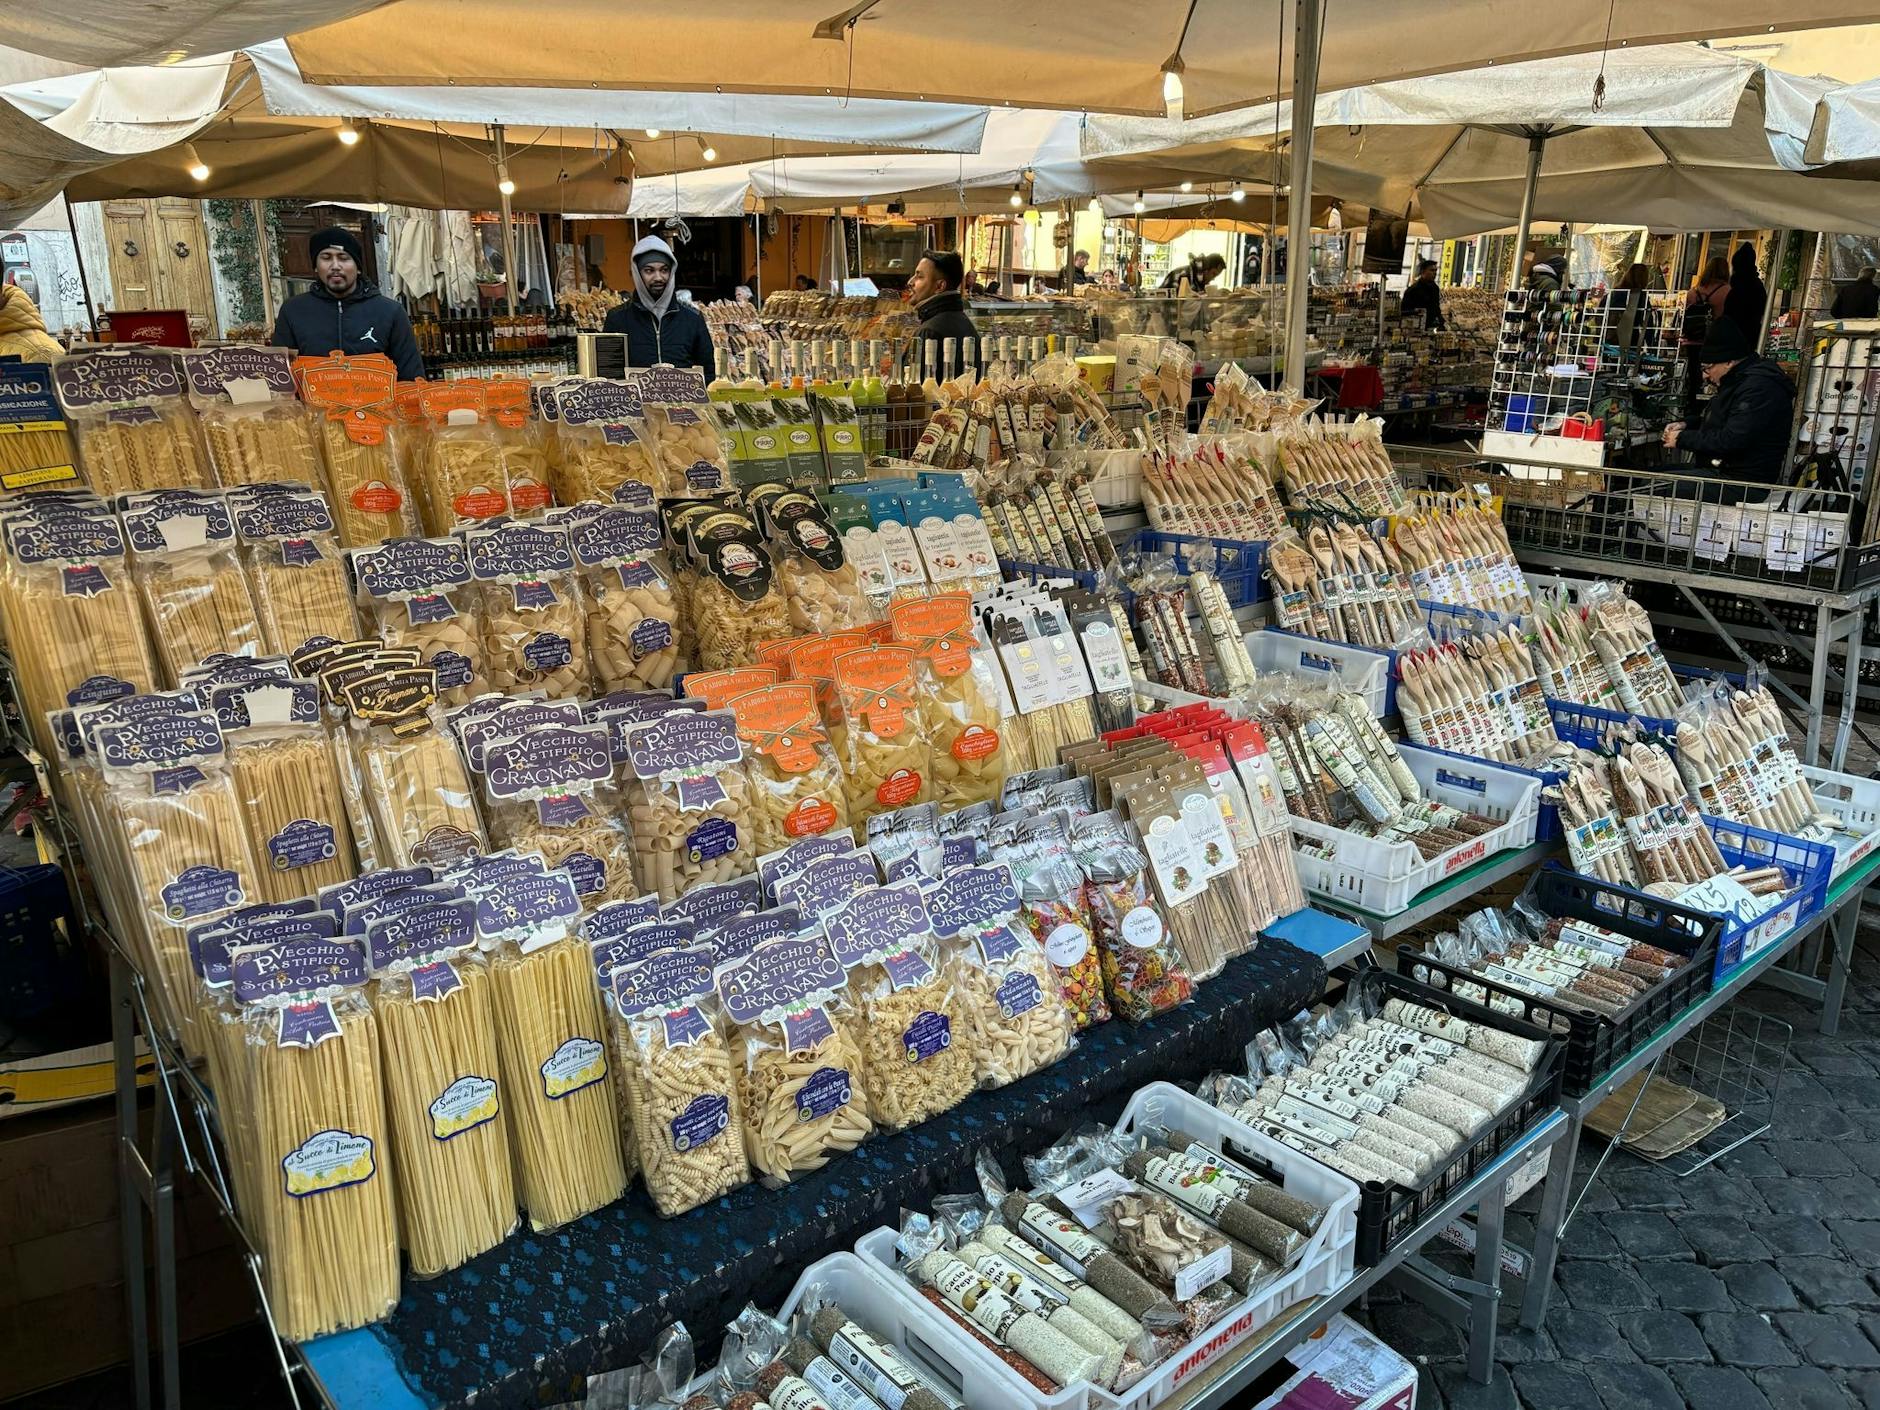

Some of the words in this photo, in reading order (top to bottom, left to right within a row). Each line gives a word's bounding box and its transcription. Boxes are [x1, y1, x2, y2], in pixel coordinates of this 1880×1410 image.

[86, 356, 153, 370] VECCHIO
[200, 360, 277, 376] PASTIFICIO
[210, 351, 271, 365] VECCHIO
[1640, 362, 1666, 372] STANLEY
[72, 365, 160, 384] PASTIFICIO
[640, 376, 697, 392] PASTIFICIO
[649, 368, 692, 382] VECCHIO
[62, 373, 175, 399] GRAGNANO
[580, 386, 626, 401] VECCHIO
[643, 387, 706, 402] RAGNANO
[564, 400, 642, 420] GRAGNANO
[572, 393, 630, 410] PASTIFICIO
[150, 505, 210, 521] VECCHIO
[248, 510, 316, 527] PASTIFICIO
[257, 502, 310, 517] VECCHIO
[38, 522, 101, 536] VECCHIO
[242, 513, 328, 536] GRAGNANO
[597, 514, 643, 531] VECCHIO
[27, 530, 108, 548] PASTIFICIO
[493, 532, 551, 545] VECCHIO
[573, 527, 660, 559] GRAGNANO
[585, 523, 647, 545] PASTIFICIO
[18, 535, 121, 559] GRAGNANO
[386, 547, 445, 562] VECCHIO
[482, 541, 556, 557] PASTIFICIO
[372, 556, 452, 577] PASTIFICIO
[472, 549, 570, 573] GRAGNANO
[362, 562, 468, 590] GRAGNANO
[210, 671, 271, 687] VECCHIO
[361, 682, 394, 696] FABBRICA
[409, 674, 430, 685] PASTA
[108, 699, 177, 716] VECCHIO
[129, 720, 198, 736] VECCHIO
[492, 710, 560, 729] VECCHIO
[655, 720, 718, 738] VECCHIO
[106, 732, 220, 761] GRAGNANO
[115, 729, 205, 748] PASTIFICIO
[516, 735, 588, 753] VECCHIO
[643, 731, 723, 751] PASTIFICIO
[503, 746, 594, 769] PASTIFICIO
[633, 735, 737, 768] GRAGNANO
[490, 751, 608, 786] GRAGNANO
[786, 842, 839, 869] VECCHIO
[472, 862, 527, 881] VECCHIO
[808, 861, 858, 890] VECCHIO
[170, 885, 197, 899] Spaghetti
[350, 875, 414, 895] VECCHIO
[500, 878, 554, 897] VECCHIO
[793, 872, 864, 902] PASTIFICIO
[946, 872, 997, 899] VECCHIO
[372, 894, 435, 914] VECCHIO
[488, 888, 561, 912] PASTIFICIO
[676, 889, 740, 917] VECCHIO
[854, 892, 903, 922] VECCHIO
[930, 884, 1017, 929] GRAGNANO
[934, 881, 1003, 913] PASTIFICIO
[398, 908, 458, 928] VECCHIO
[483, 895, 573, 926] SAPORITI
[592, 905, 646, 926] VECCHIO
[839, 903, 911, 935] PASTIFICIO
[236, 922, 313, 942] VECCHIO
[384, 917, 462, 944] PASTIFICIO
[619, 928, 677, 949] VECCHIO
[712, 919, 780, 947] VECCHIO
[834, 904, 924, 957] GRAGNANO
[269, 945, 346, 961] VECCHIO
[375, 926, 470, 960] SAPORITI
[608, 937, 682, 965] PASTIFICIO
[253, 956, 351, 976] PASTIFICIO
[640, 955, 697, 974] VECCHIO
[752, 943, 814, 971] VECCHIO
[241, 967, 360, 992] SAPORITI
[630, 964, 701, 991] PASTIFICIO
[727, 957, 839, 1011] GRAGNANO
[734, 955, 822, 994] PASTIFICIO
[619, 967, 712, 1007] GRAGNANO
[551, 1055, 571, 1072] Succo
[579, 1045, 602, 1059] Limone
[440, 1093, 462, 1110] Succo
[470, 1083, 494, 1098] Limone
[297, 1148, 324, 1164] Succo
[335, 1140, 368, 1155] Limone
[944, 1269, 966, 1294] Cacio
[955, 1273, 976, 1294] Pepe
[1172, 1310, 1254, 1384] antonella
